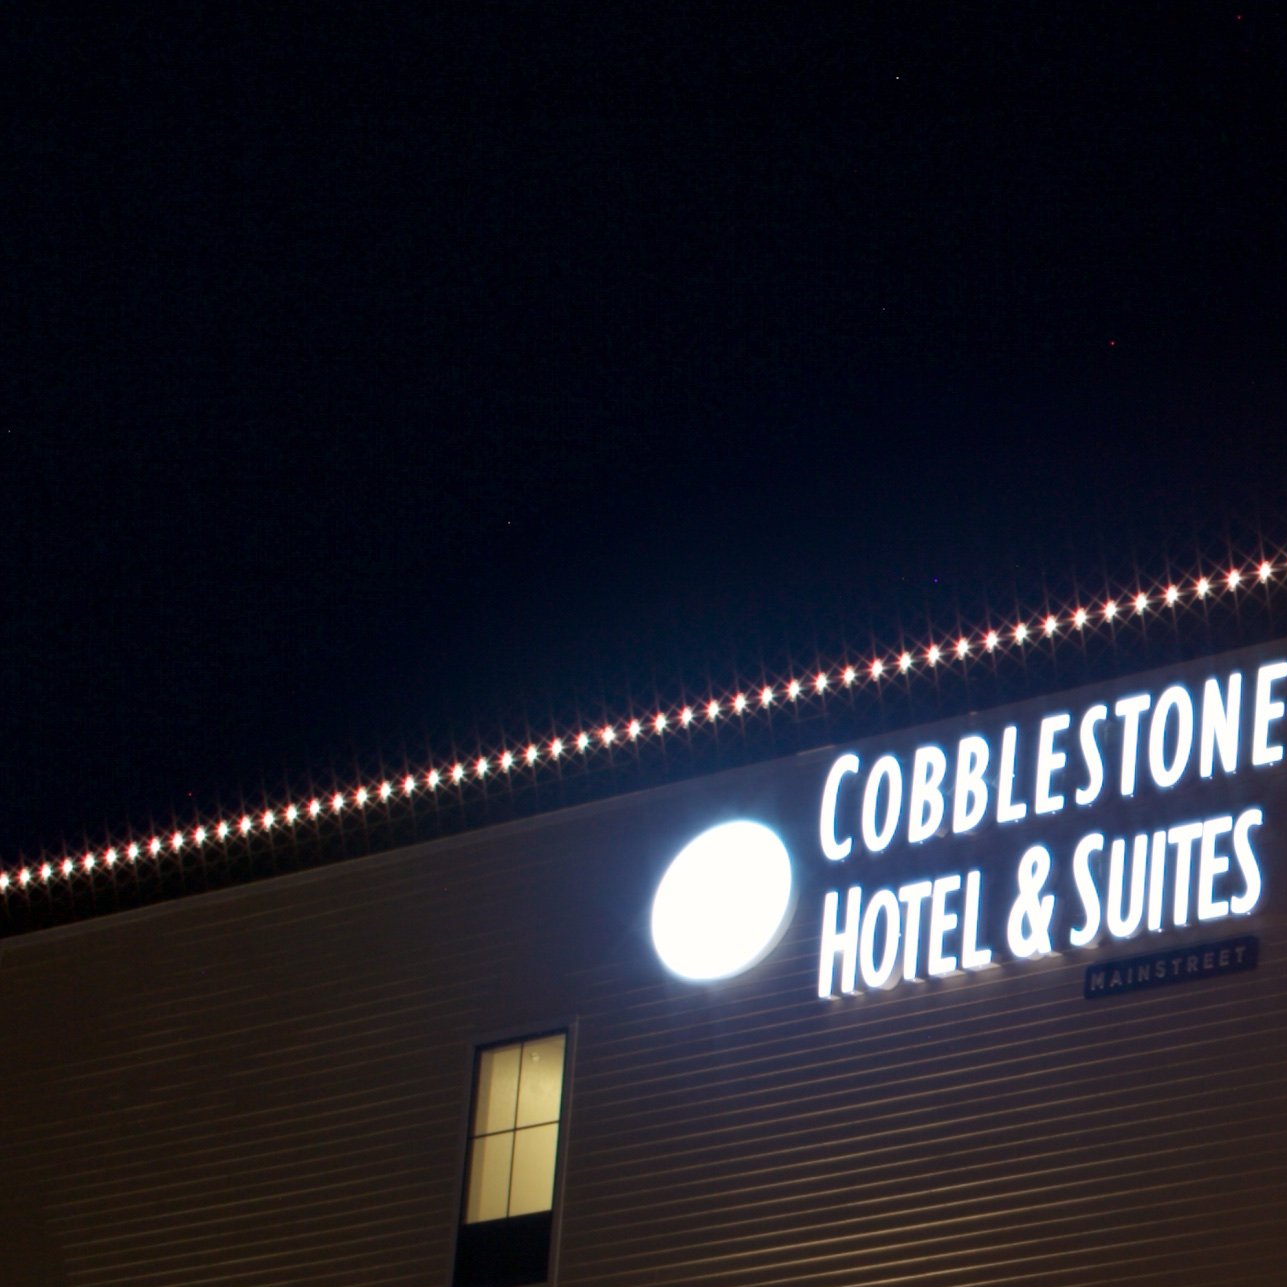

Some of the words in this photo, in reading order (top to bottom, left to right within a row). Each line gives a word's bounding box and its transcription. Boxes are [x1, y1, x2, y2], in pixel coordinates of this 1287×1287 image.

[817, 870, 992, 999] HOTEL
[1006, 844, 1056, 958] &
[1069, 808, 1264, 947] SUITES
[1090, 946, 1247, 991] MAINSTREET
